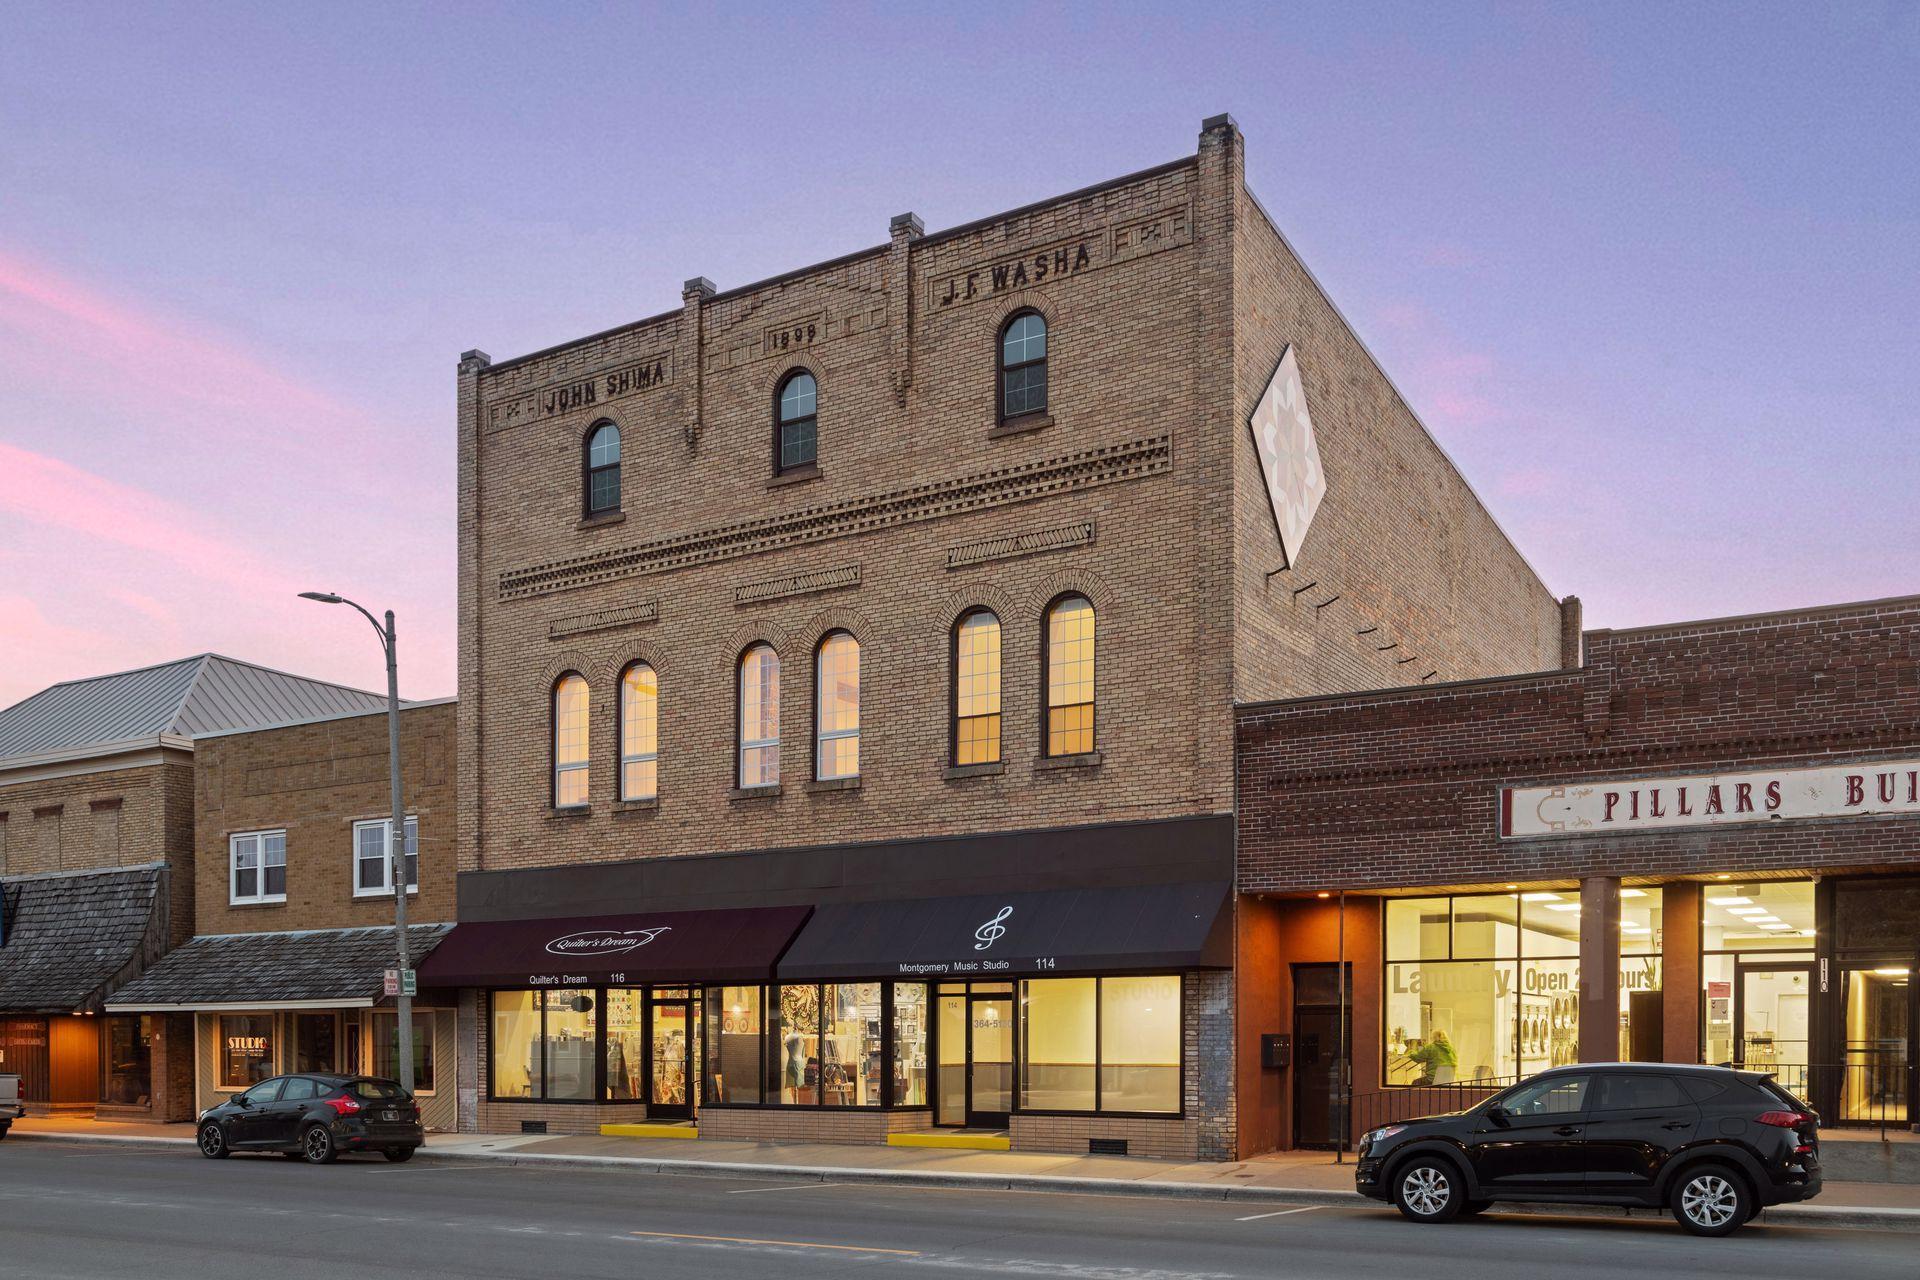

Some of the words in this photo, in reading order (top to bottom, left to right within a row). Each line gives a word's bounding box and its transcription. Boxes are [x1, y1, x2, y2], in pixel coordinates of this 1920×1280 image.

[992, 243, 1089, 293] WASHA
[773, 324, 816, 349] 1898
[545, 381, 596, 414] JOHN
[606, 362, 664, 396] SHIMA
[1602, 780, 1782, 822] PILLARS
[557, 938, 600, 950] Quilter's
[600, 937, 638, 947] Dream
[899, 963, 949, 974] Montgomery
[954, 961, 979, 971] Music
[983, 960, 1010, 970] Studio
[1036, 957, 1055, 969] 114
[529, 975, 559, 984] Quilter's
[563, 974, 588, 984] Dream
[610, 973, 625, 983] 116
[1393, 965, 1511, 998] Launy
[1525, 967, 1568, 994] Open
[228, 1037, 267, 1048] STUDIO
